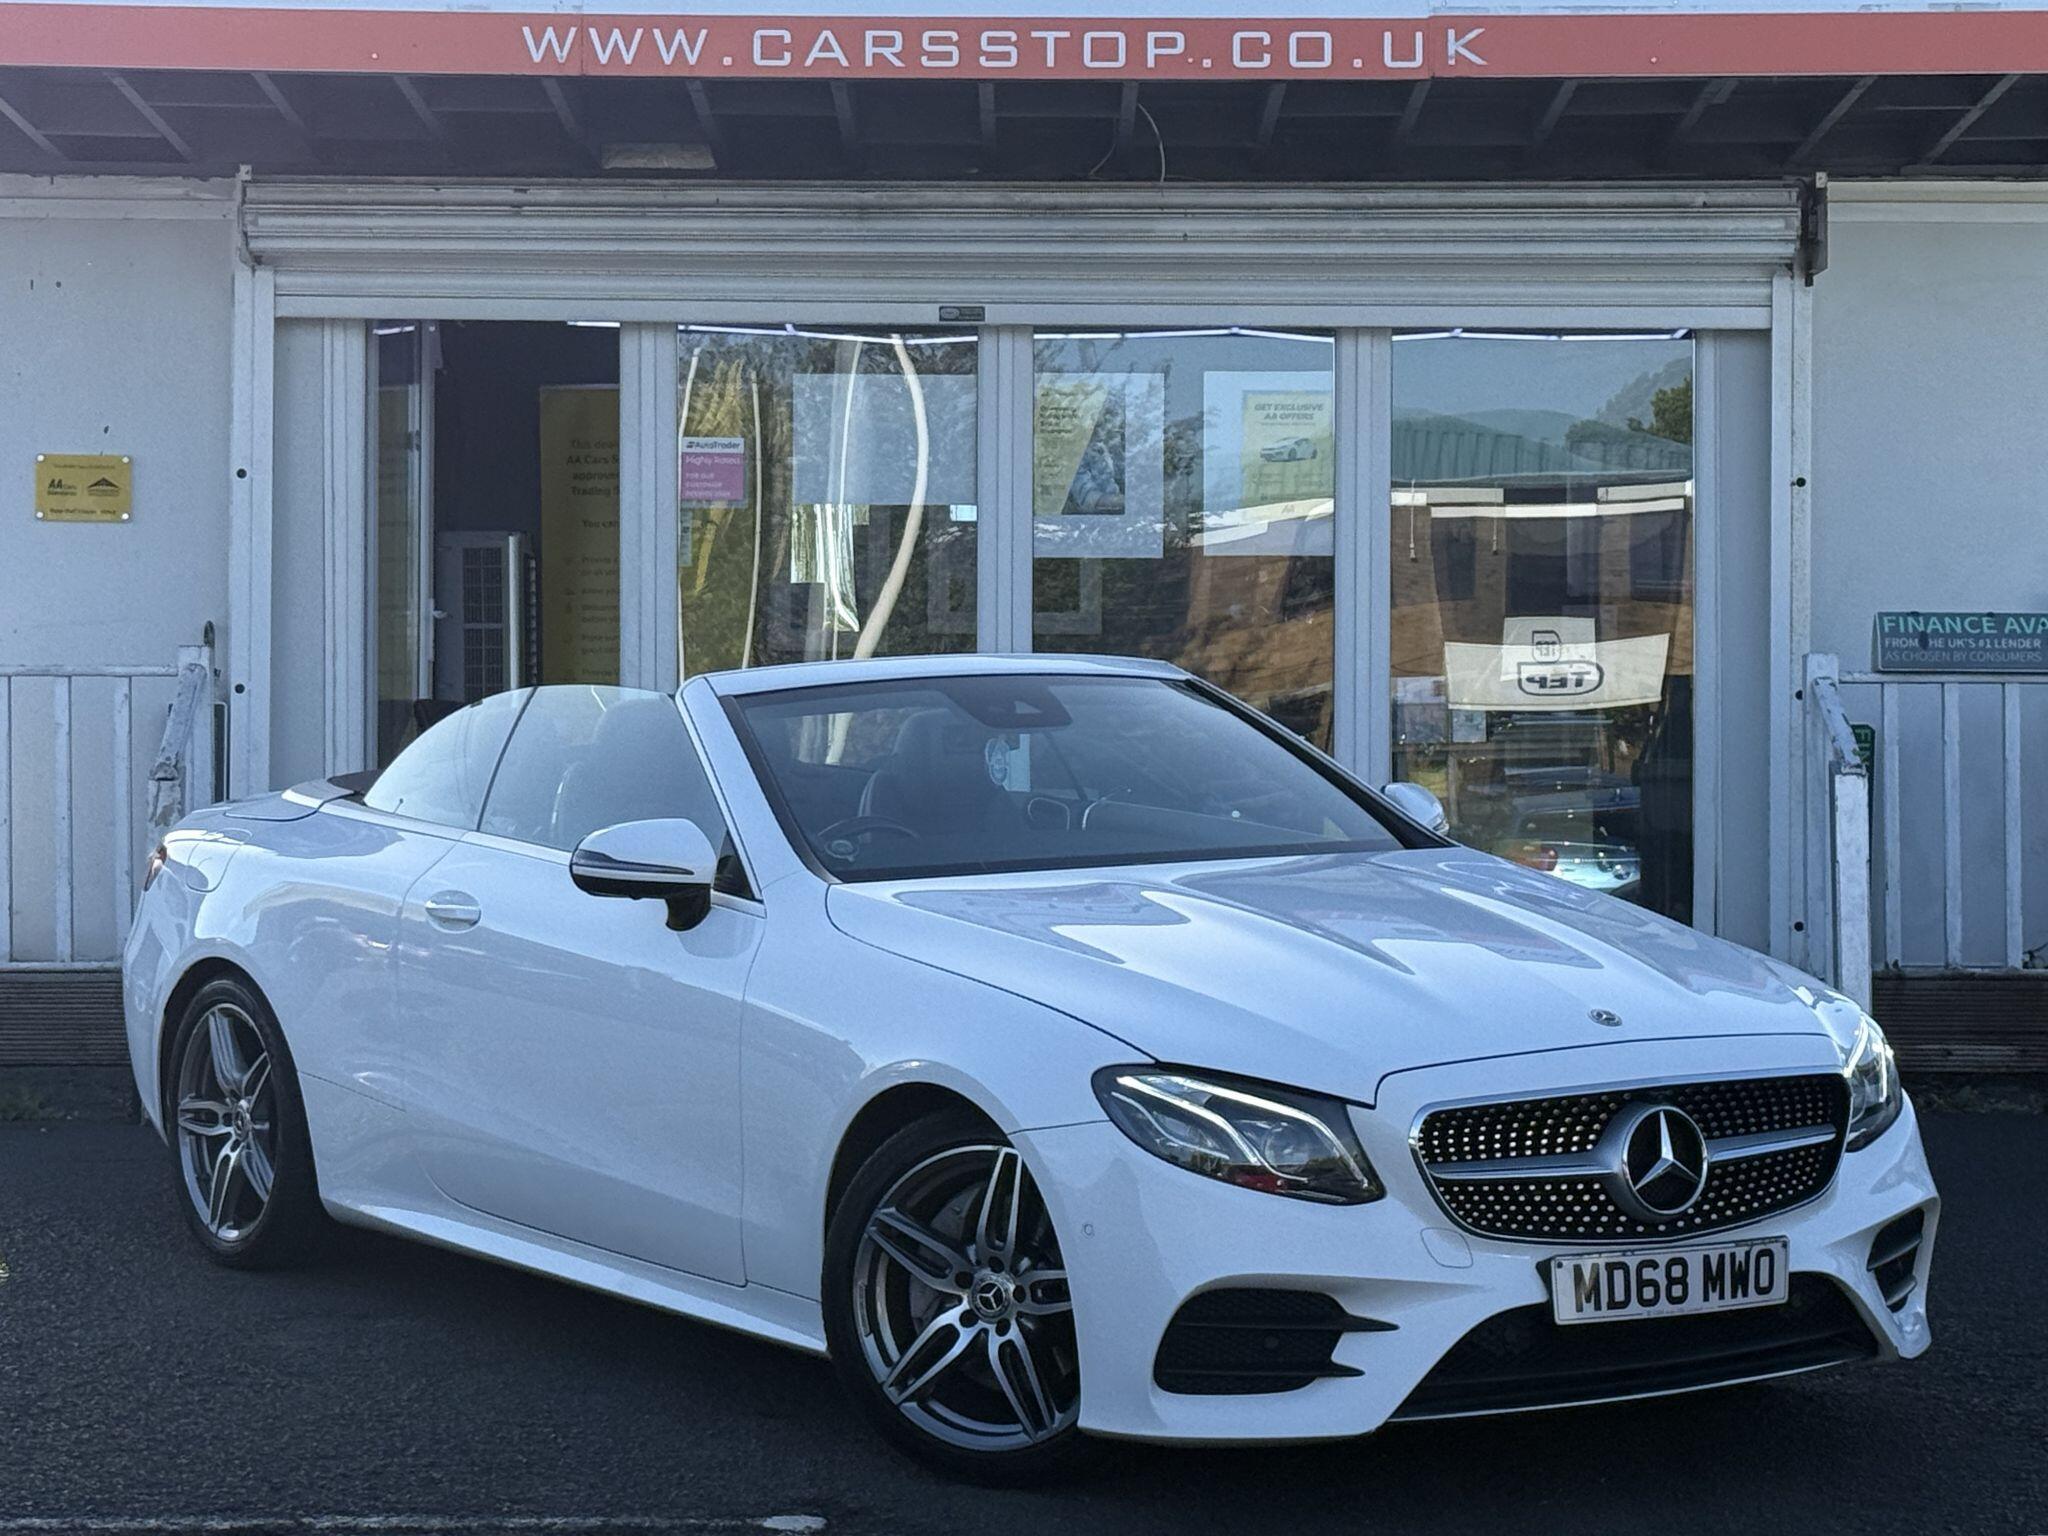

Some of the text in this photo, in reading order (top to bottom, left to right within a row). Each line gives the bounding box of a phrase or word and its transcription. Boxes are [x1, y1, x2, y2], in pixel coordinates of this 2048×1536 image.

[522, 26, 1487, 68] WWW.CARSSTOP.CO.UK
[1882, 616, 1998, 634] FINANCE
[1884, 637, 2042, 649] FROM HE UK'S #1 LENDER
[1885, 651, 2043, 663] AS CHOSEN BY CONSUMERS
[1572, 1248, 1775, 1313] MD68 MWO
